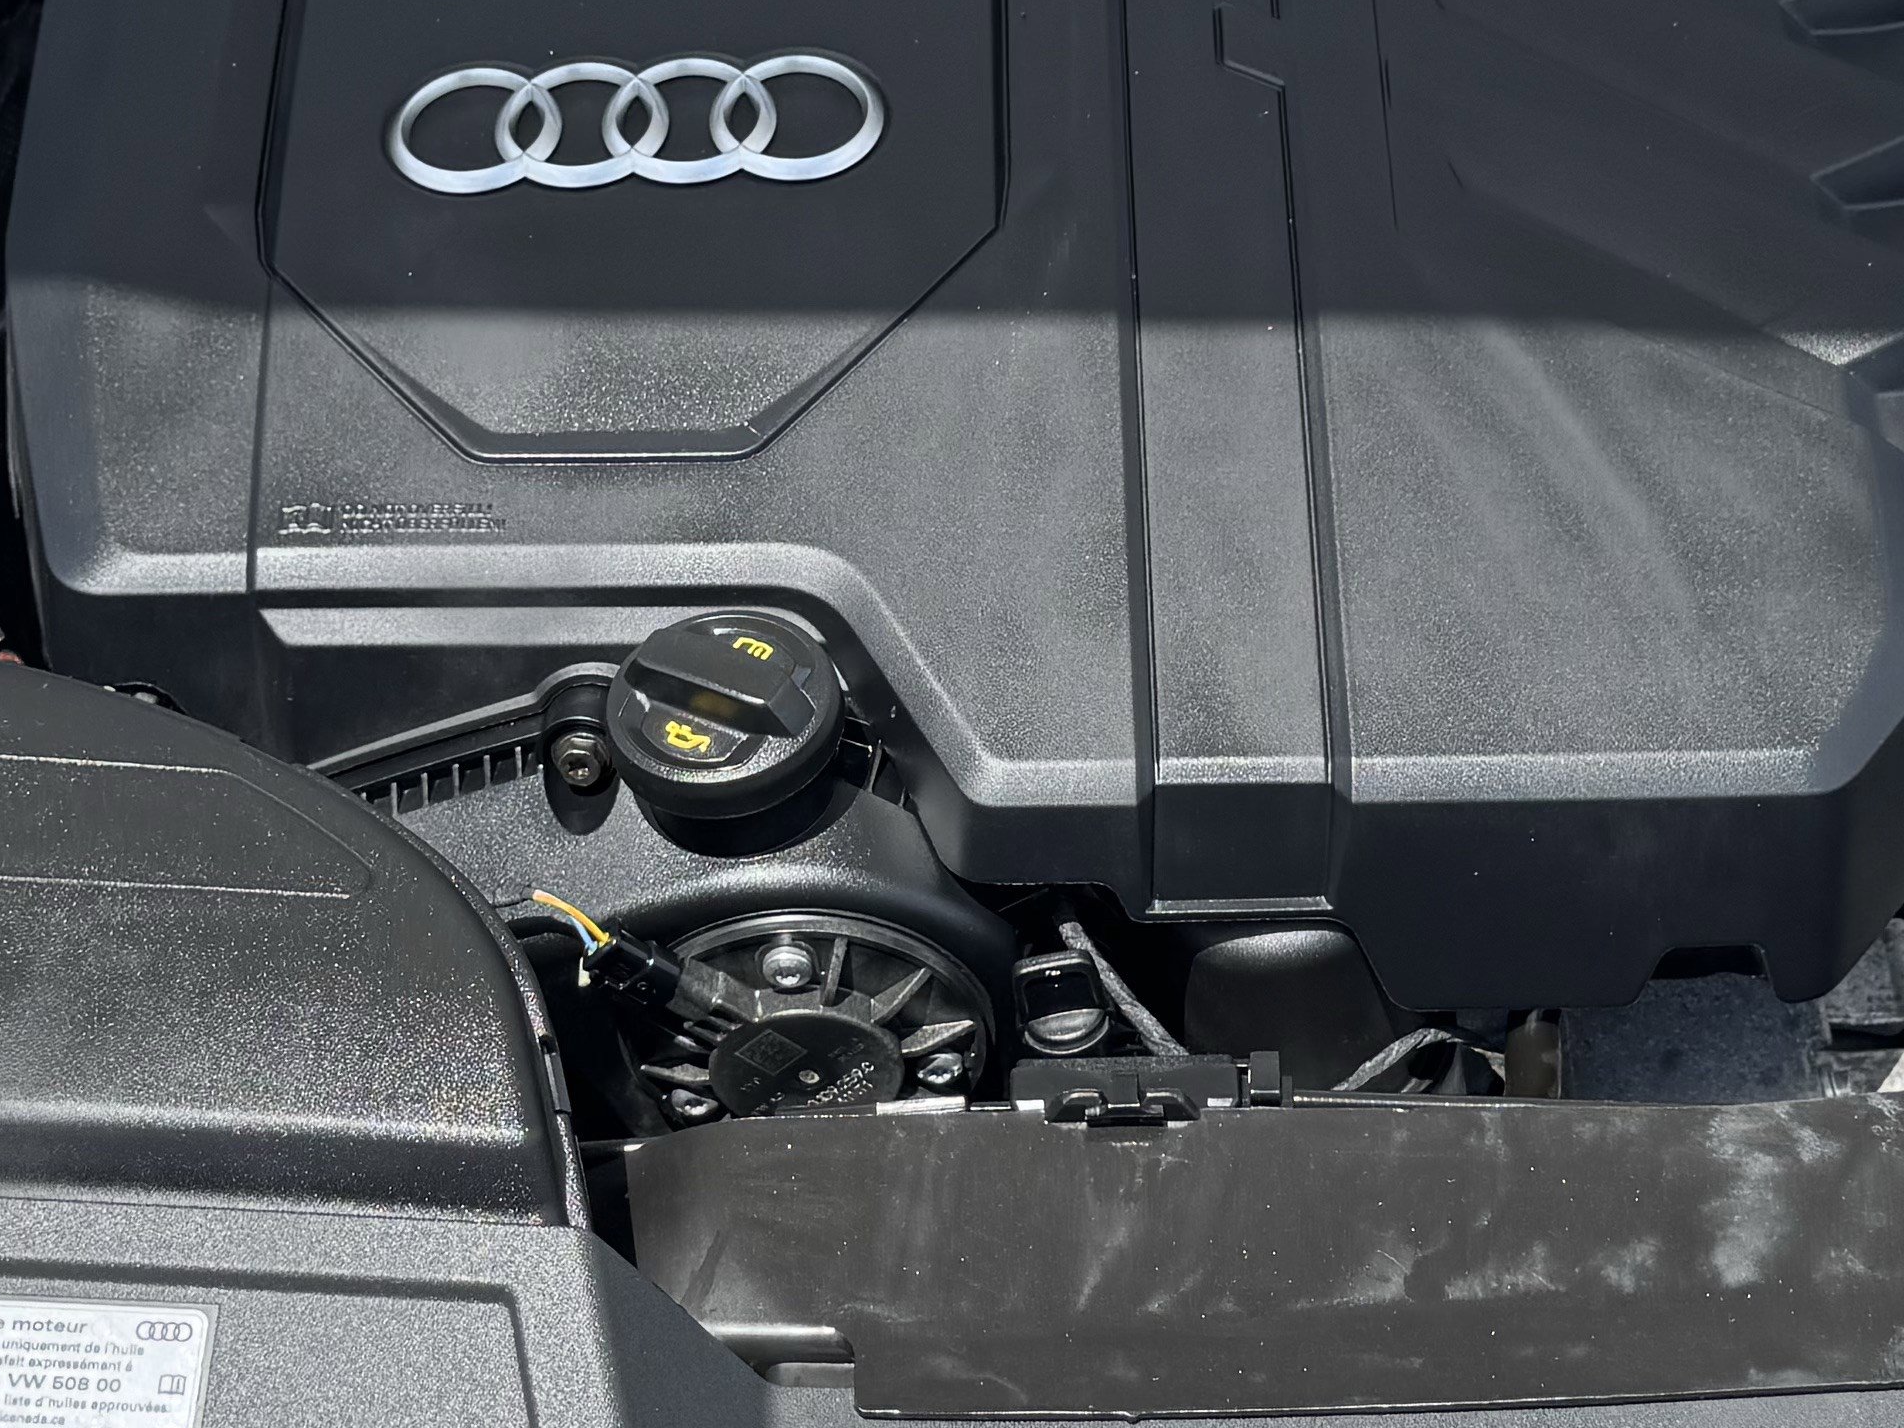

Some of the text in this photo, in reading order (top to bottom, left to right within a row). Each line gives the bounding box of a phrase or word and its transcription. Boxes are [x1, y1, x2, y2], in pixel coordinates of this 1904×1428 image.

[12, 1318, 88, 1334] moteur
[2, 1338, 80, 1354] uniquement
[84, 1342, 100, 1354] de
[28, 1356, 122, 1372] expressément
[8, 1373, 47, 1390] VW
[52, 1375, 90, 1391] 508
[96, 1378, 122, 1393] 00
[4, 1393, 30, 1406] liste
